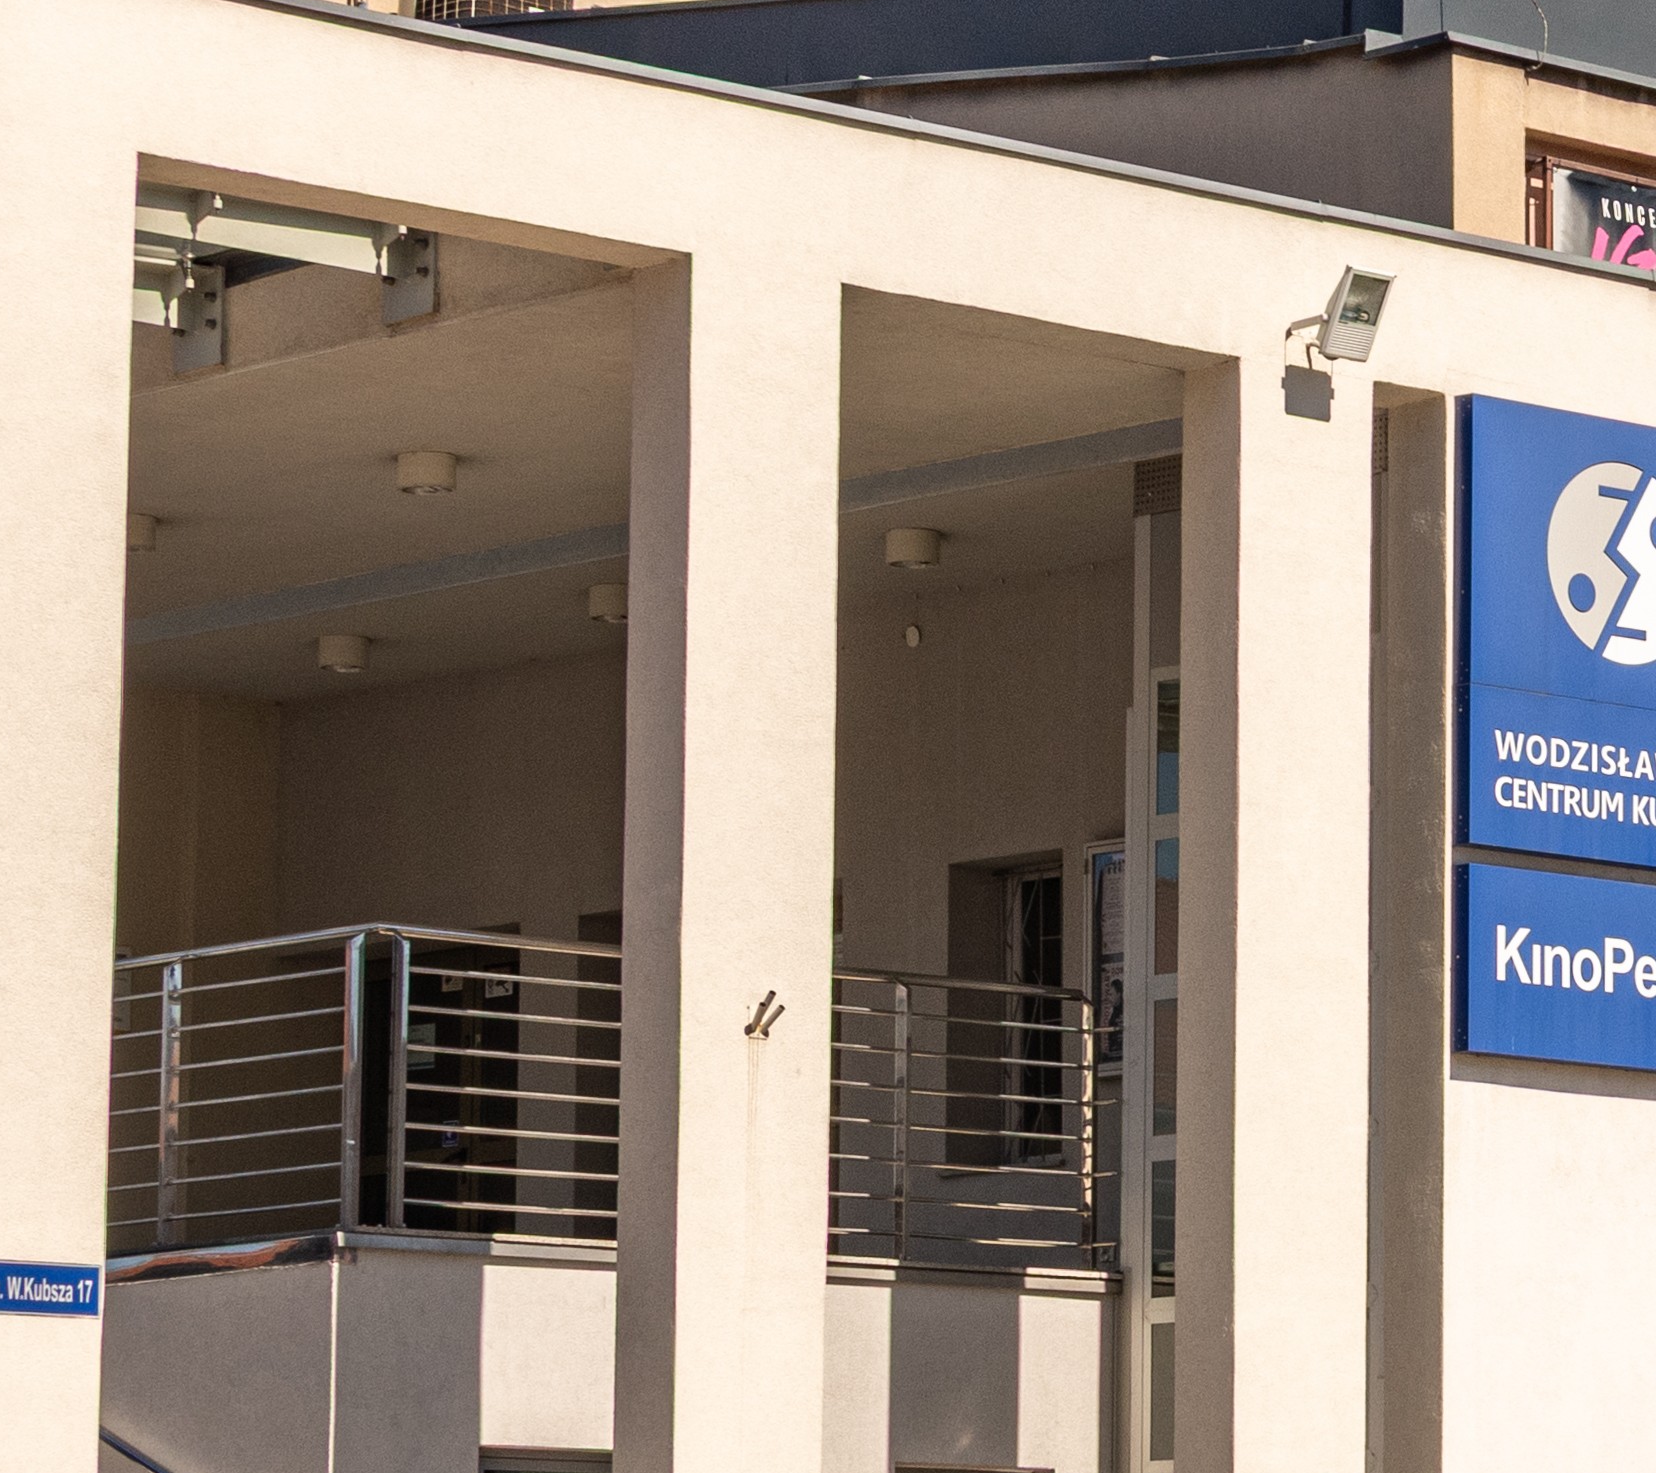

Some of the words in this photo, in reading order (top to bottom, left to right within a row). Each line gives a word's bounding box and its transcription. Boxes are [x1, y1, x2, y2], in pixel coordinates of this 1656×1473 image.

[1494, 776, 1624, 822] CENTRUM
[7, 1276, 73, 1303] W.Kubsza
[77, 1279, 94, 1304] 17
